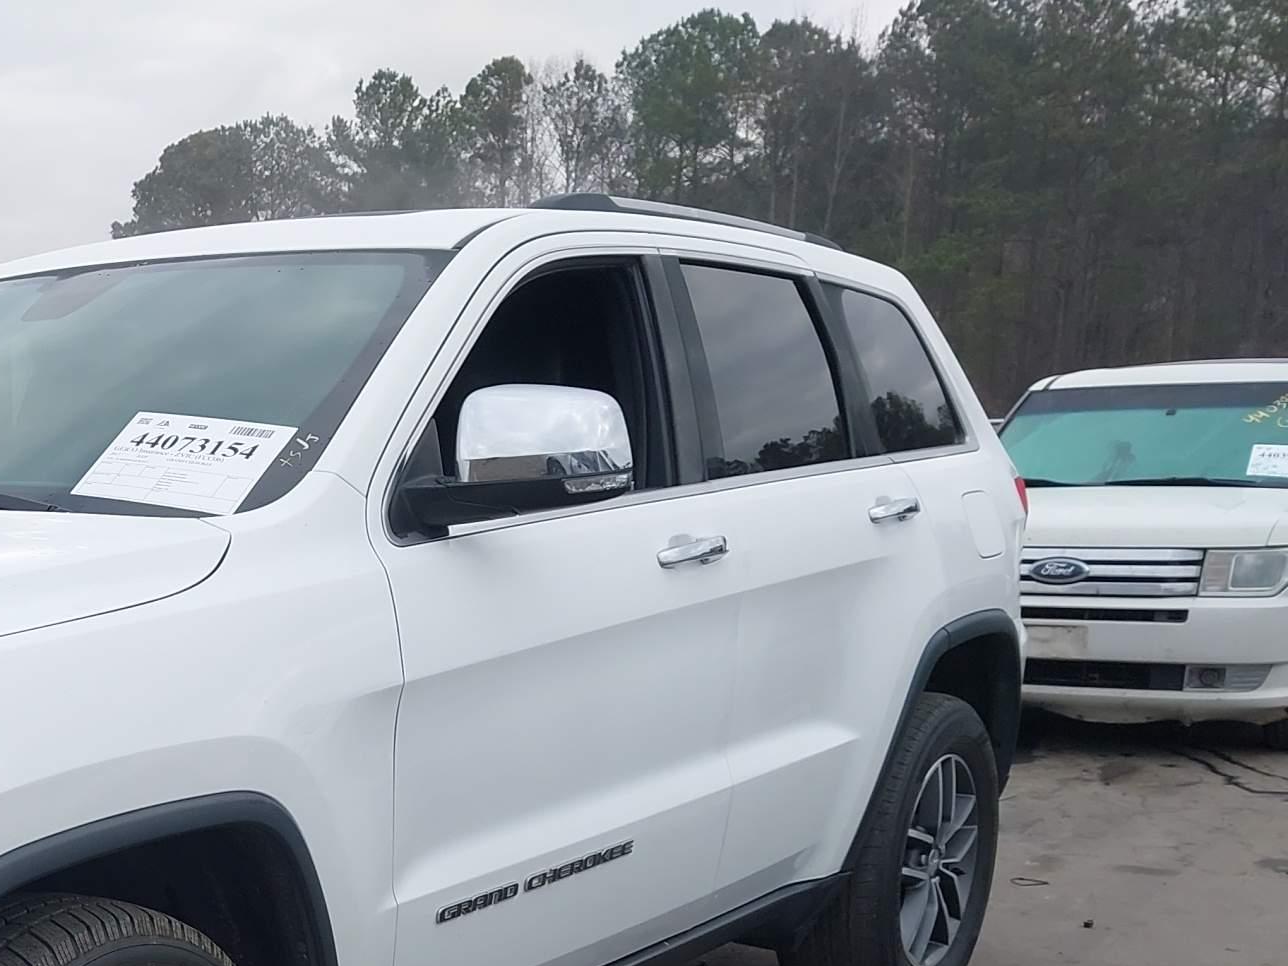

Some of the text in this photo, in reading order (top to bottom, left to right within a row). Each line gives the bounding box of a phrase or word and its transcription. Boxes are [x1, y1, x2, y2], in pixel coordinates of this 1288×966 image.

[130, 432, 260, 460] 44073154
[1040, 562, 1075, 577] Ford
[435, 839, 635, 924] GRAND CHEROKEE
